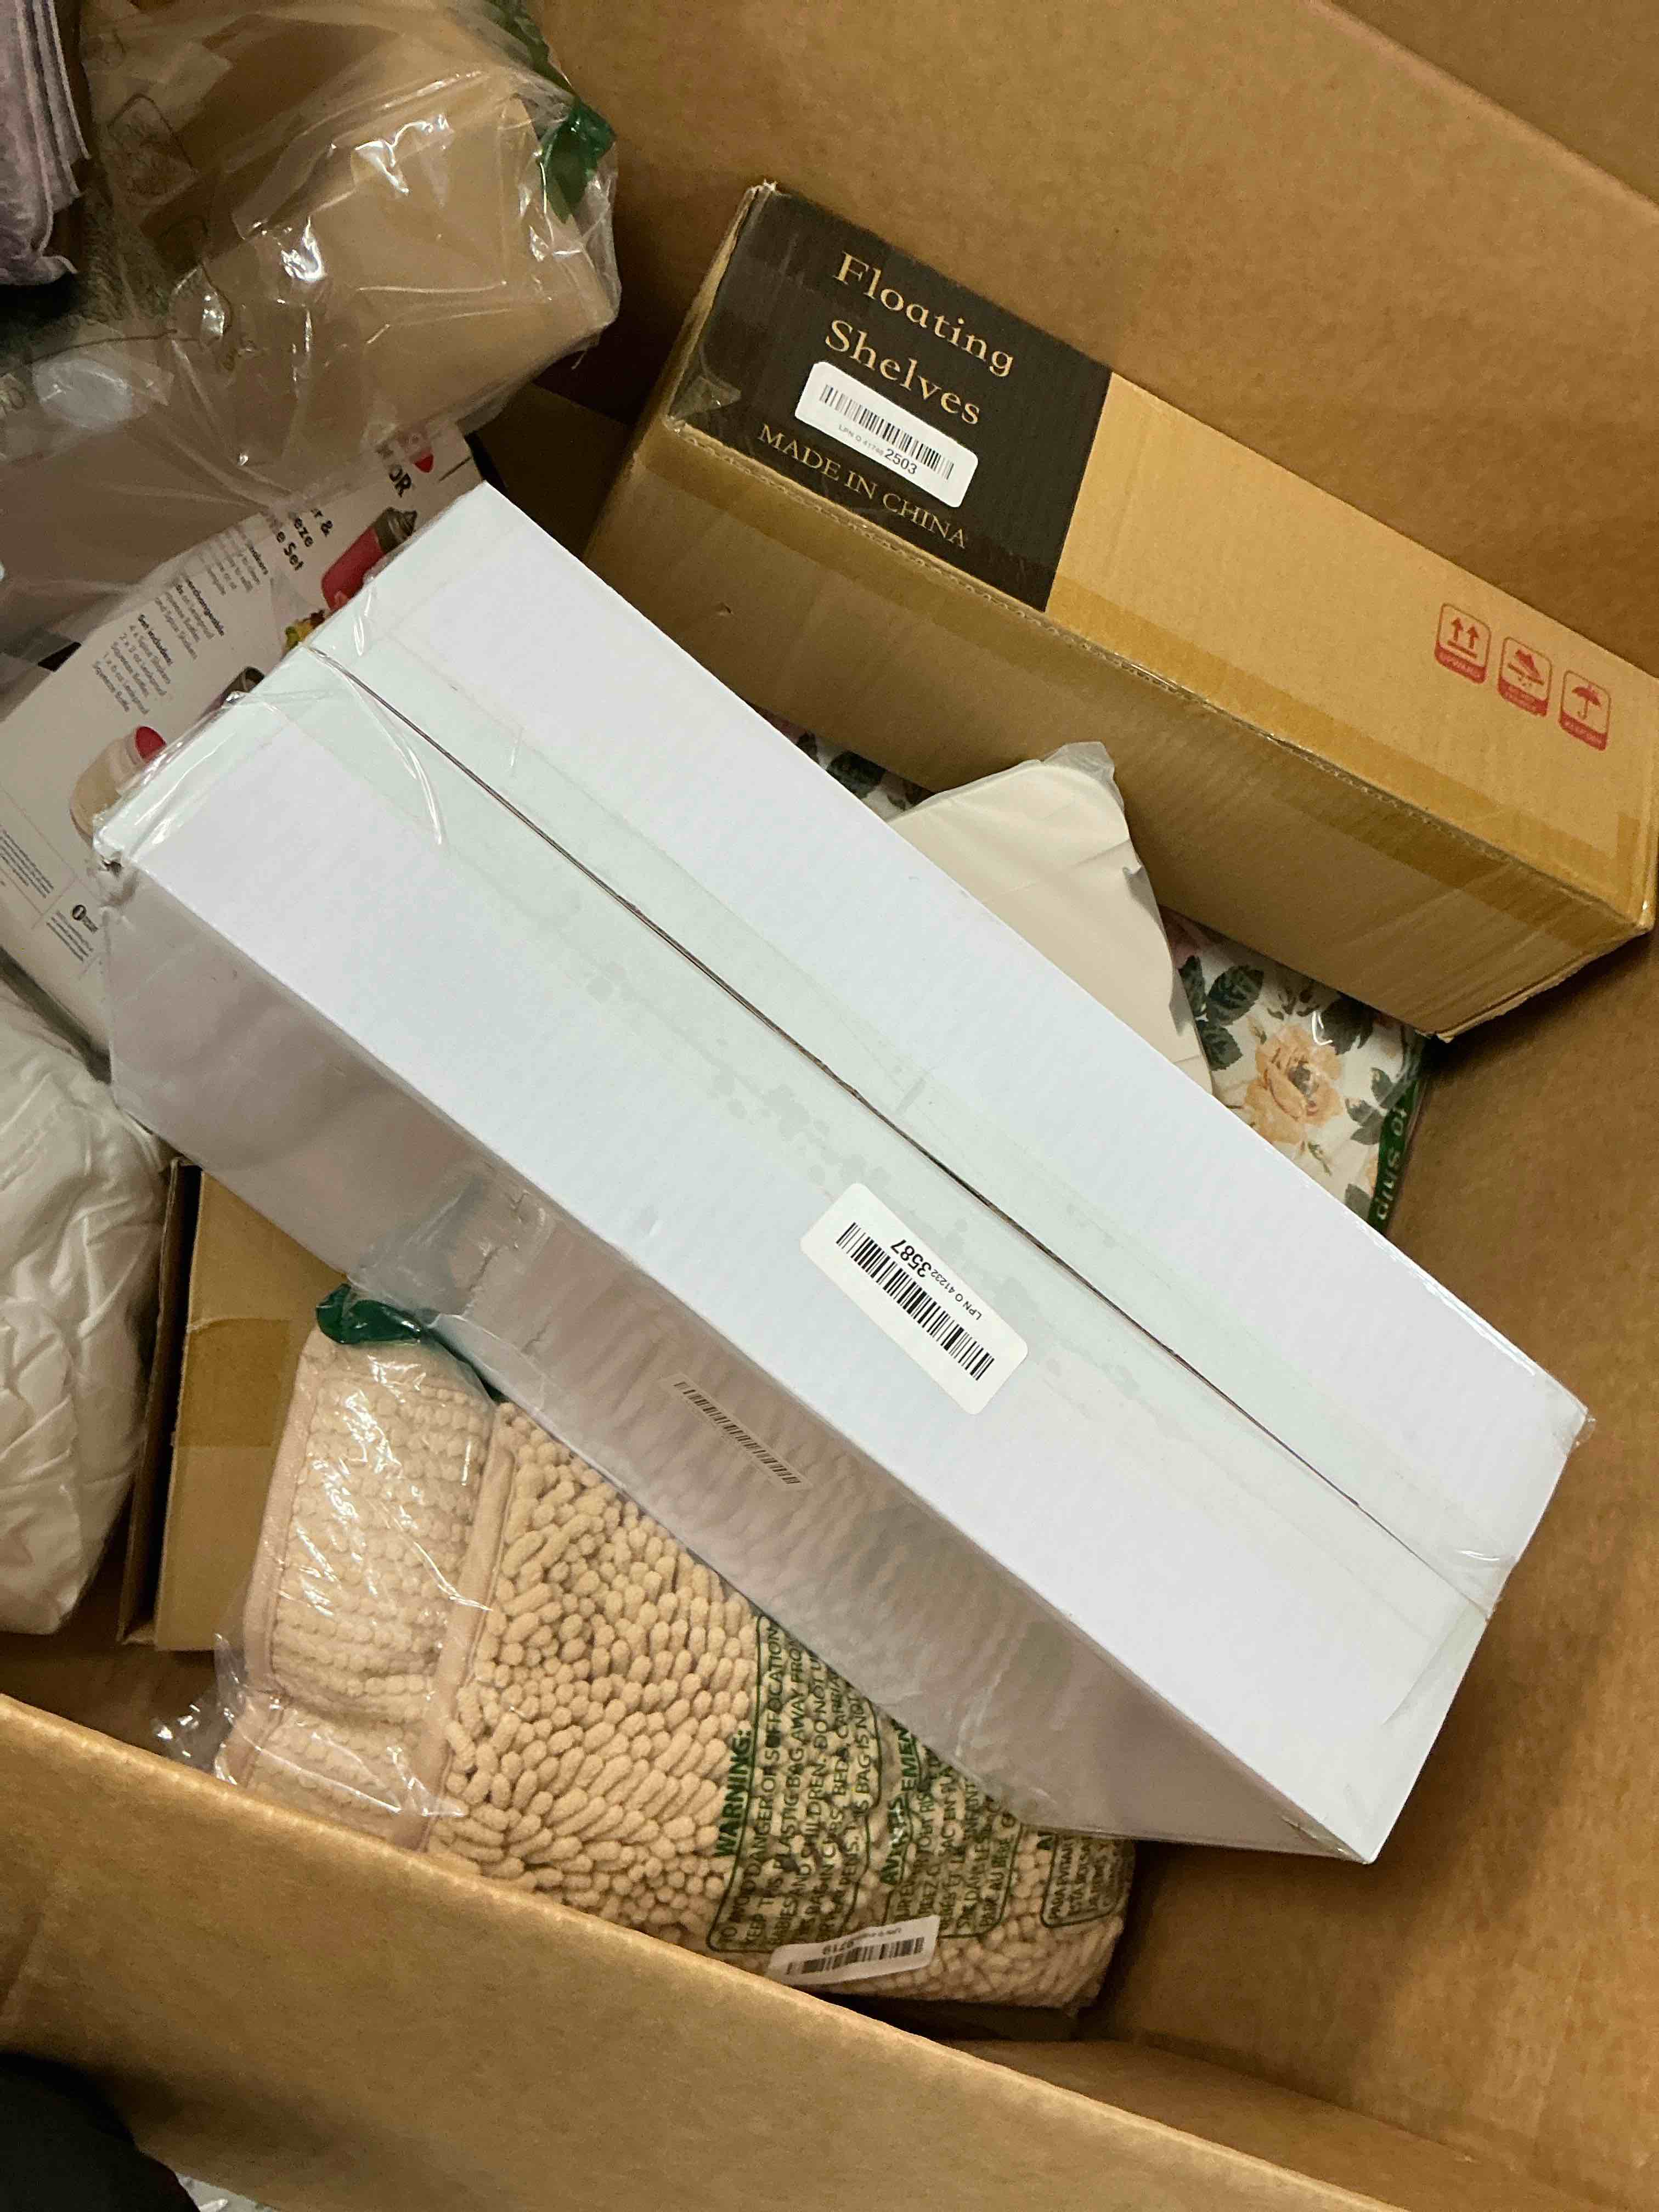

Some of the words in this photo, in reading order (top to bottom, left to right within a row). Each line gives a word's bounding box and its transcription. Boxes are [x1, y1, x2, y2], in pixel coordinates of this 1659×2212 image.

[834, 252, 1015, 377] Floating
[825, 320, 981, 426] Shelves
[884, 449, 917, 475] 2503
[758, 424, 841, 482] MADE
[845, 470, 878, 500] IN
[882, 493, 967, 550] CHINA
[283, 541, 304, 572] Set
[963, 1301, 983, 1321] LPN
[790, 1688, 809, 1744] AWAY
[812, 1681, 827, 1714] NOT
[848, 1696, 867, 1729] NOT
[786, 1747, 804, 1788] BAG
[855, 1753, 872, 1794] BAG
[713, 1729, 751, 1857] WARNING:
